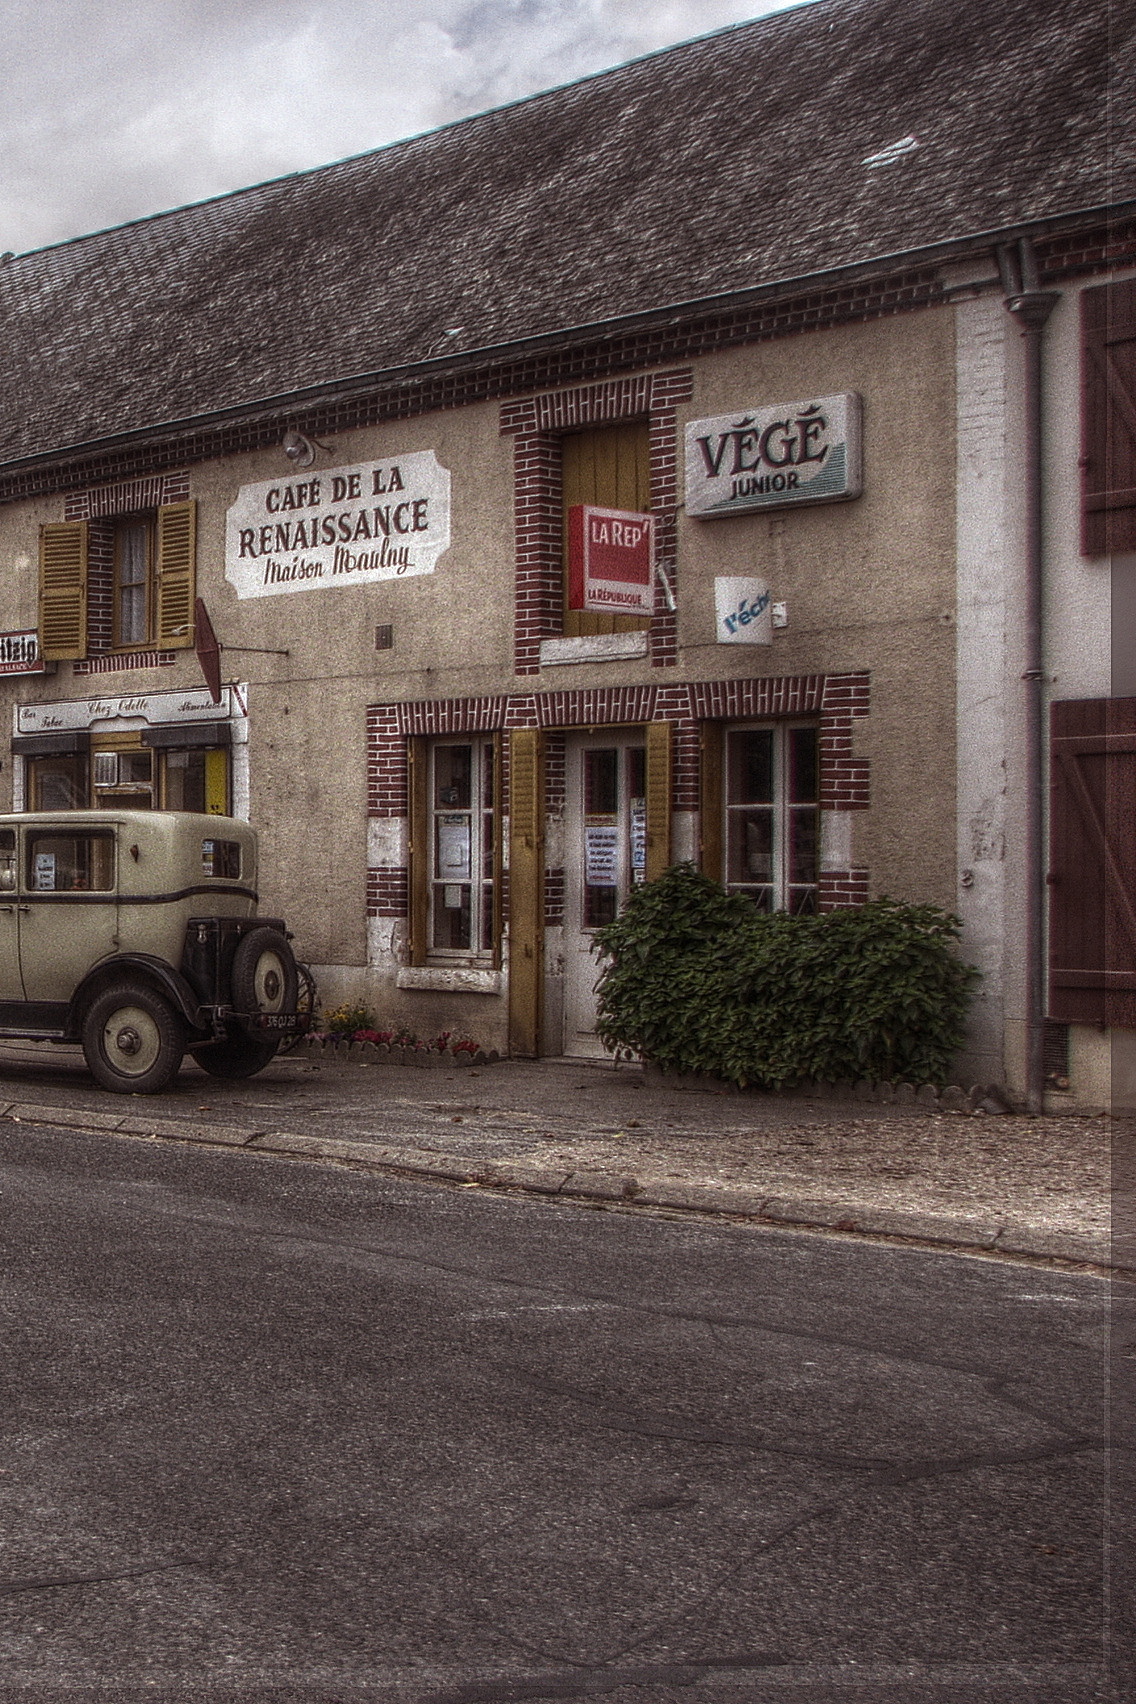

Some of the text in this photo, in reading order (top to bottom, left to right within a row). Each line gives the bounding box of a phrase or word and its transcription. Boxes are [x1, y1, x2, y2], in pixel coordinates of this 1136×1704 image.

[695, 404, 829, 478] VÉGÉ
[331, 473, 362, 503] DE
[372, 466, 405, 496] LA
[730, 471, 800, 500] JUNIOR
[238, 499, 429, 559] RENAISSANCE
[592, 521, 608, 544] LA
[264, 556, 325, 585] Maison
[87, 702, 111, 717] Chez
